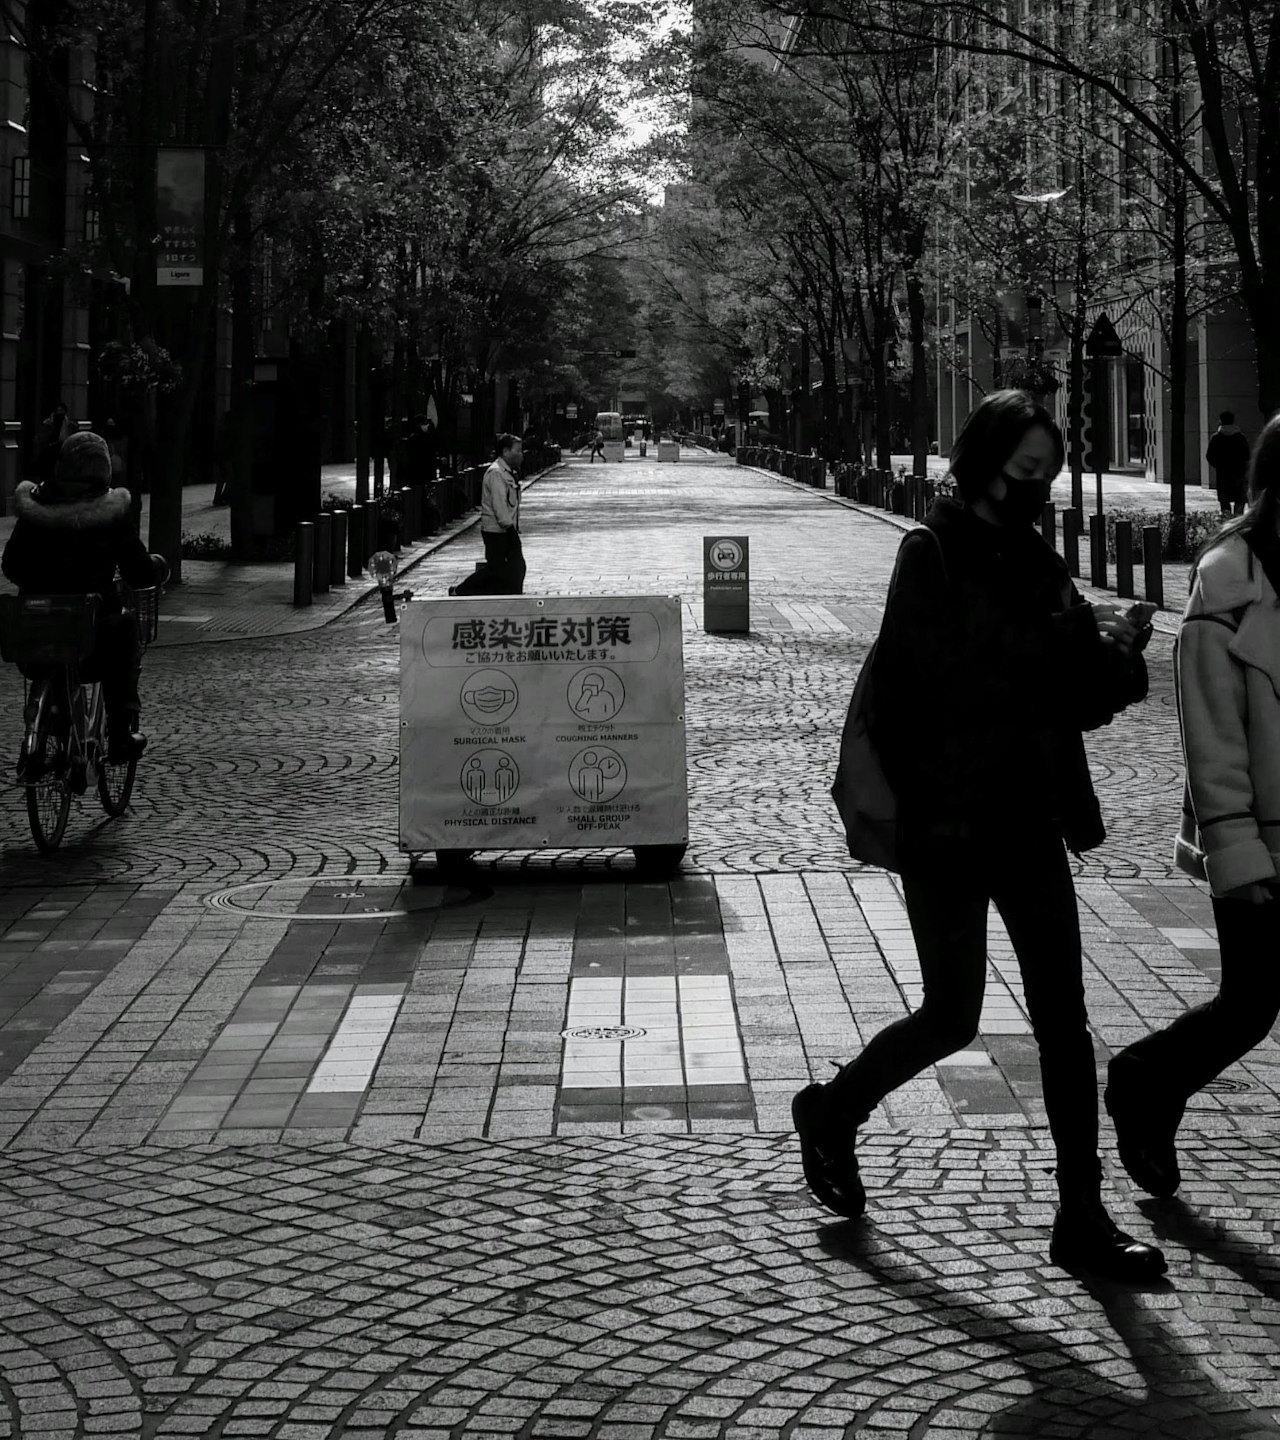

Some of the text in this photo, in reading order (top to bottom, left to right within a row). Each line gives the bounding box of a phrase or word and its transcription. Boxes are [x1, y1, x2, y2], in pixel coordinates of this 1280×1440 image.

[452, 616, 632, 650] 感染症対策
[465, 648, 616, 664] ご協力をお願いいたします。
[453, 735, 526, 745] SURGICAL MASK
[555, 734, 639, 743] COUGHING MANNERS
[444, 816, 537, 827] PHYSICAL DISTANCE
[567, 814, 631, 823] SMALL GROUP
[577, 823, 621, 831] OFF-PEAK
